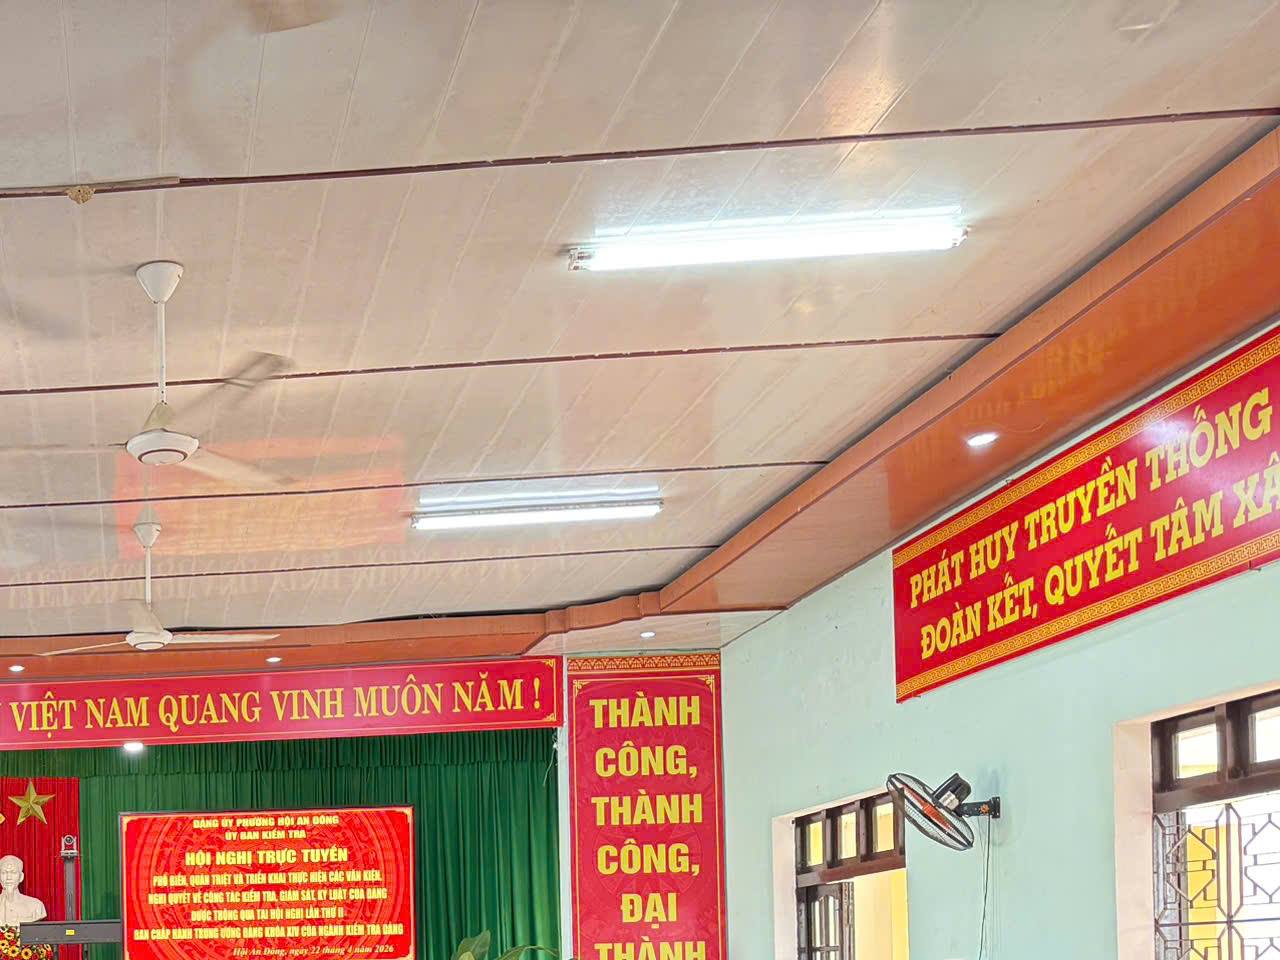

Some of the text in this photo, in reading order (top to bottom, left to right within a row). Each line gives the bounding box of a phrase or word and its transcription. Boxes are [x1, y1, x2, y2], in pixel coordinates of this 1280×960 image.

[909, 387, 1272, 609] PHÁT HUY TRUYỀN THỐNG
[921, 600, 982, 660] ĐOÀN
[986, 573, 1039, 632] KẾT,
[1044, 523, 1143, 607] QUYẾT
[1150, 491, 1225, 562] TÂM
[8, 690, 76, 739] VIỆT
[84, 697, 150, 729] NAM
[158, 690, 262, 733] QUANG
[269, 688, 344, 722] VINH
[353, 674, 443, 717] MUÔN
[451, 672, 524, 712] NĂM
[533, 677, 541, 710] !
[589, 691, 701, 729] THÀNH
[595, 740, 699, 780] CÔNG,
[591, 789, 704, 827] THÀNH
[185, 844, 348, 868] HỘI NGHỊ TRỰC TUYẾN
[597, 838, 701, 878] CÔNG,
[620, 893, 678, 929] ĐẠI
